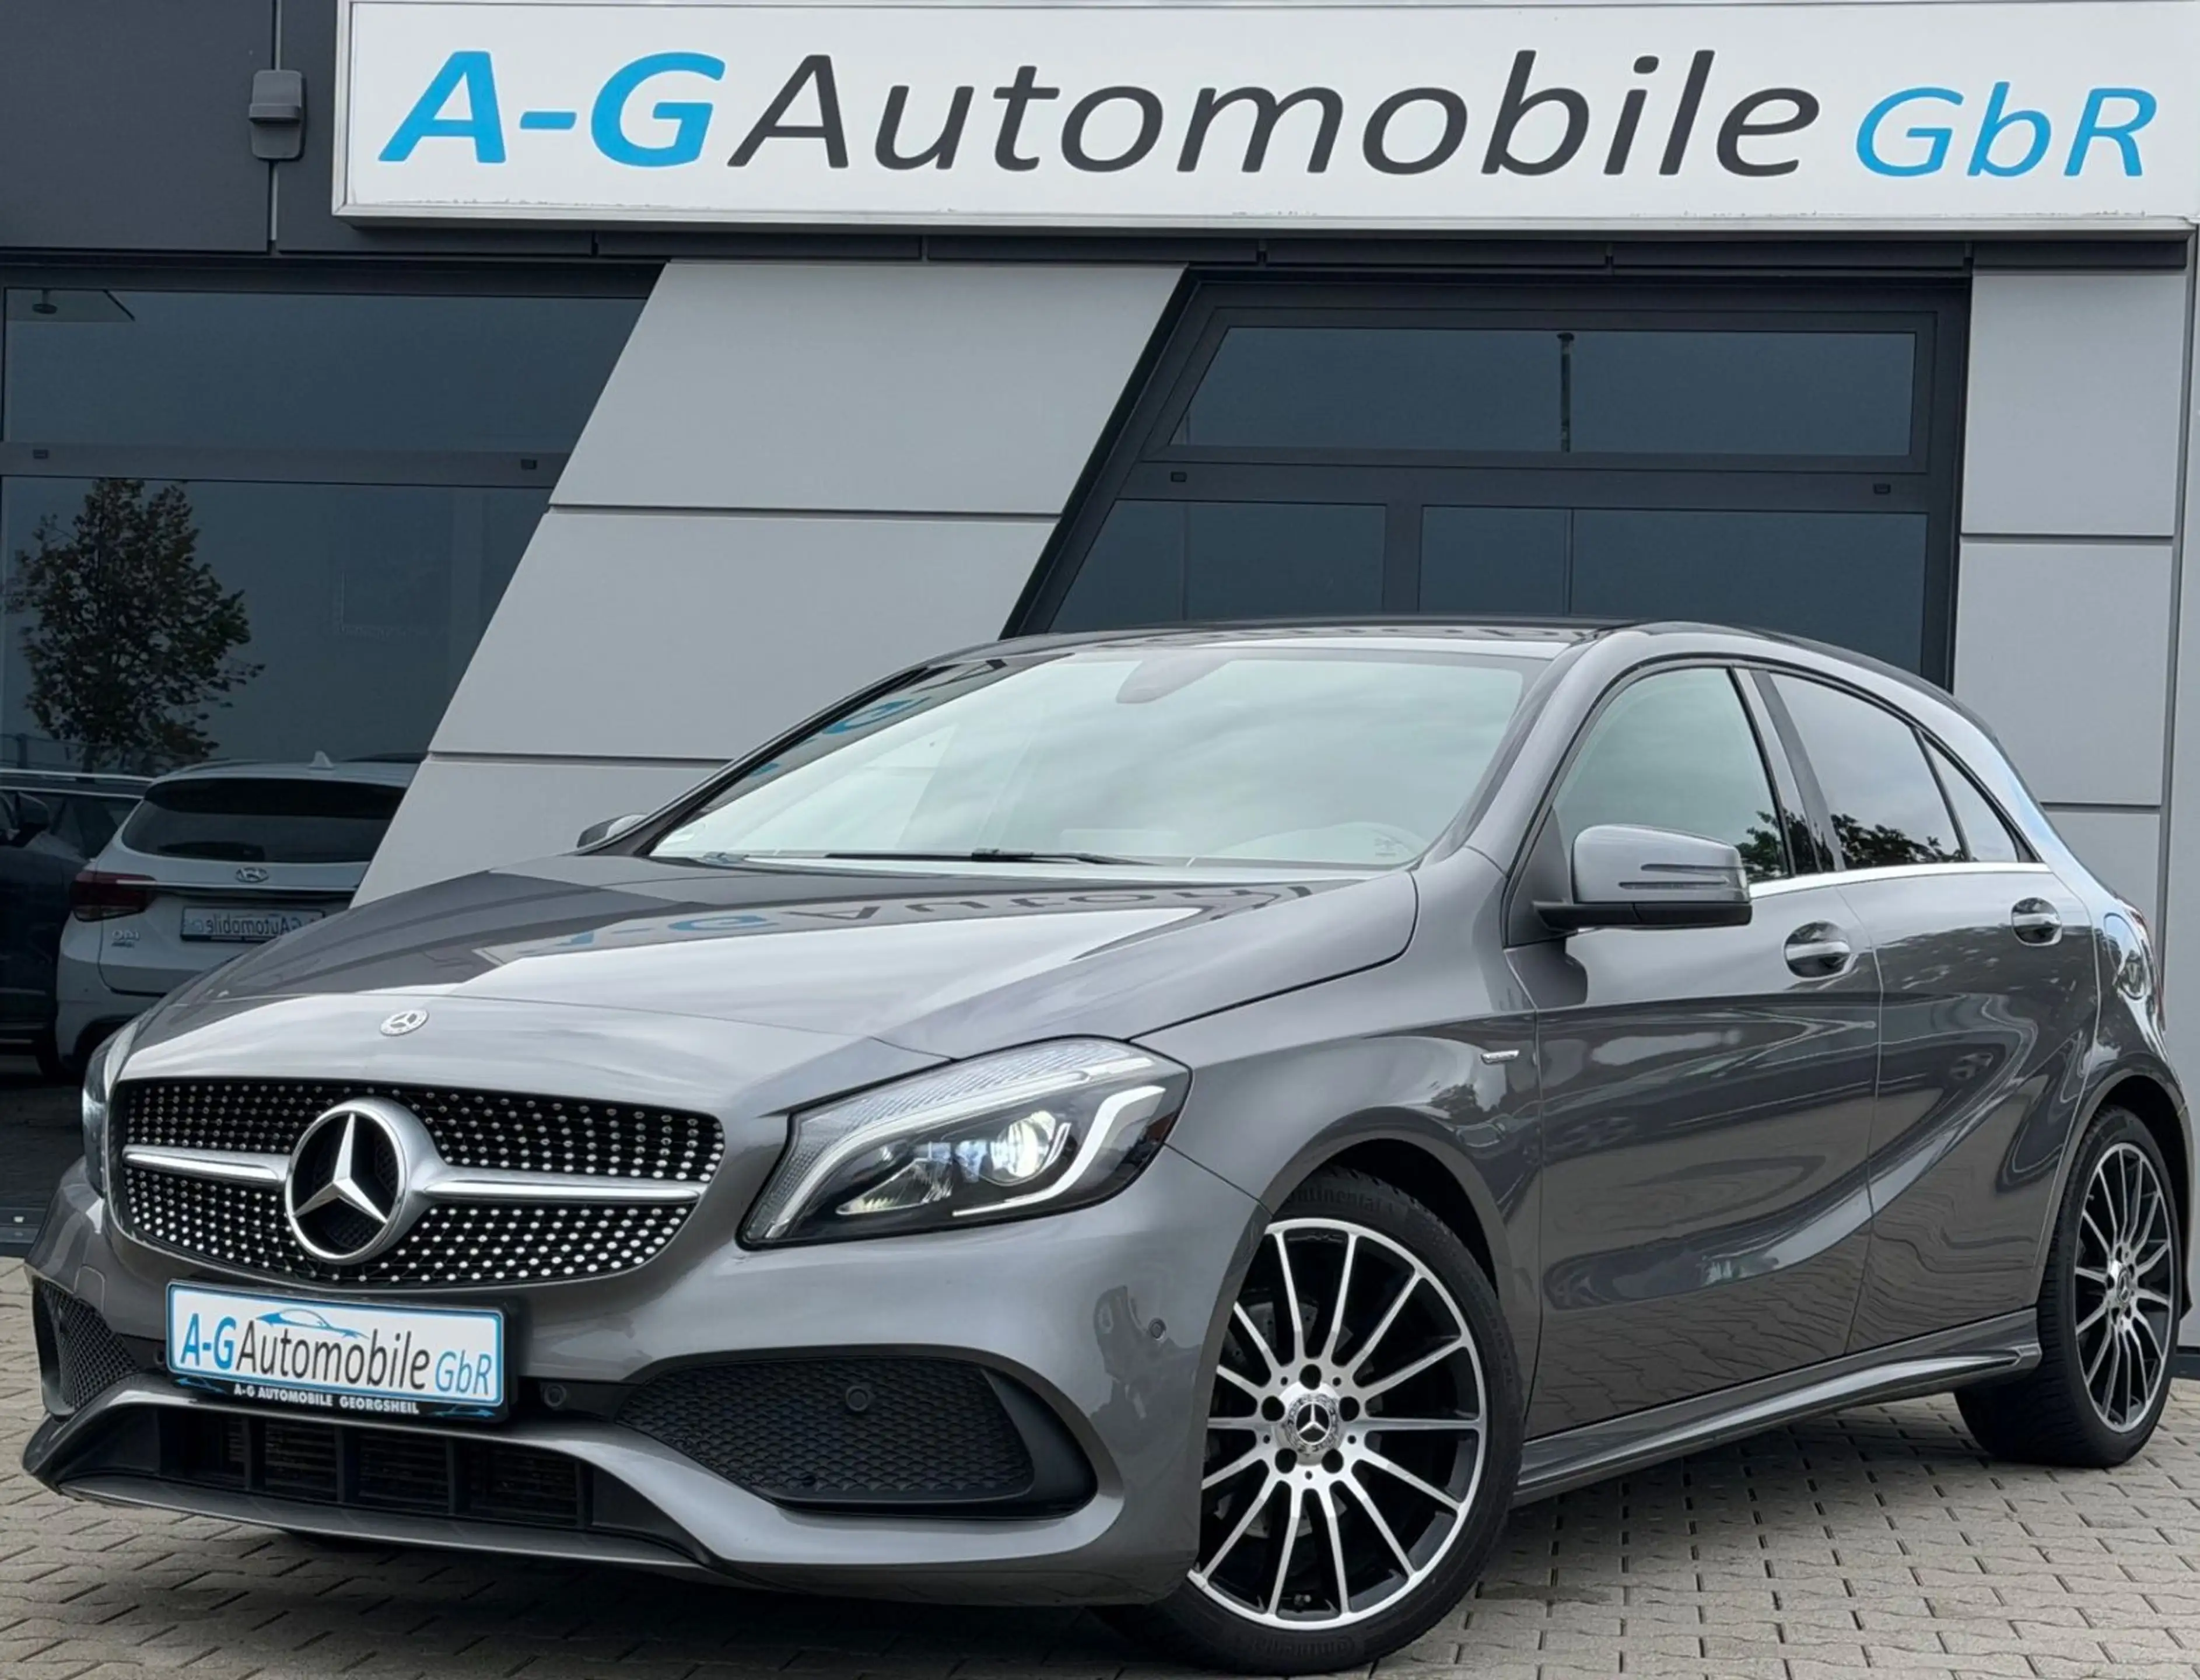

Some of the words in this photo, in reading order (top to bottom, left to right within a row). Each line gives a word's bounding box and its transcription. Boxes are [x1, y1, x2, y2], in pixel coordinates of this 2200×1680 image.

[1856, 82, 2156, 177] GbR
[435, 1349, 492, 1395] GbR
[234, 1384, 254, 1398] A-G
[257, 1386, 334, 1406] AUTOMOBILE
[339, 1396, 420, 1414] GEORGSHEIL
